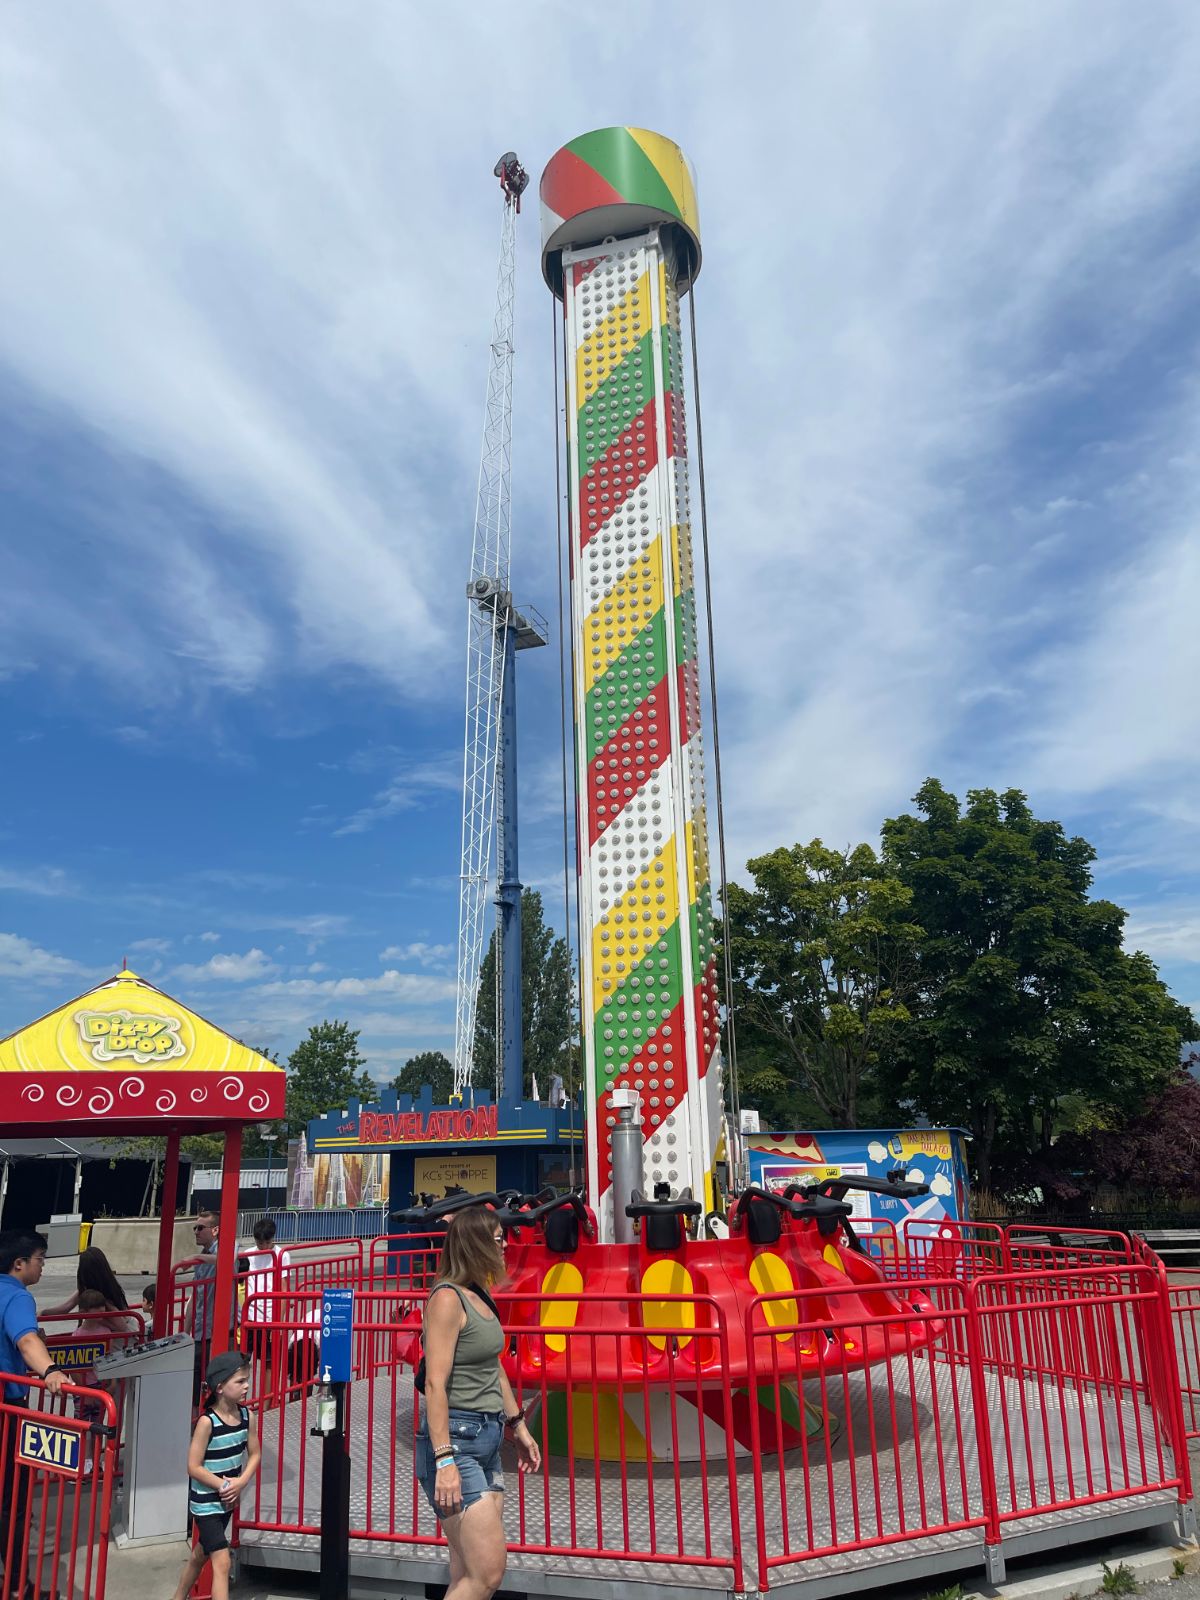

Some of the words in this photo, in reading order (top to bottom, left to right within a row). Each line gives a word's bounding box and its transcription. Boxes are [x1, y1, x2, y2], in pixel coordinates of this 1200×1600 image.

[90, 1018, 167, 1037] Dizzy
[109, 1036, 173, 1054] Drop
[336, 1121, 356, 1135] THE
[358, 1105, 498, 1143] REVELATION
[422, 1170, 442, 1181] KC's
[444, 1168, 489, 1181] SHOPPE
[49, 1347, 101, 1366] TRANCE
[23, 1424, 76, 1465] EXIT
